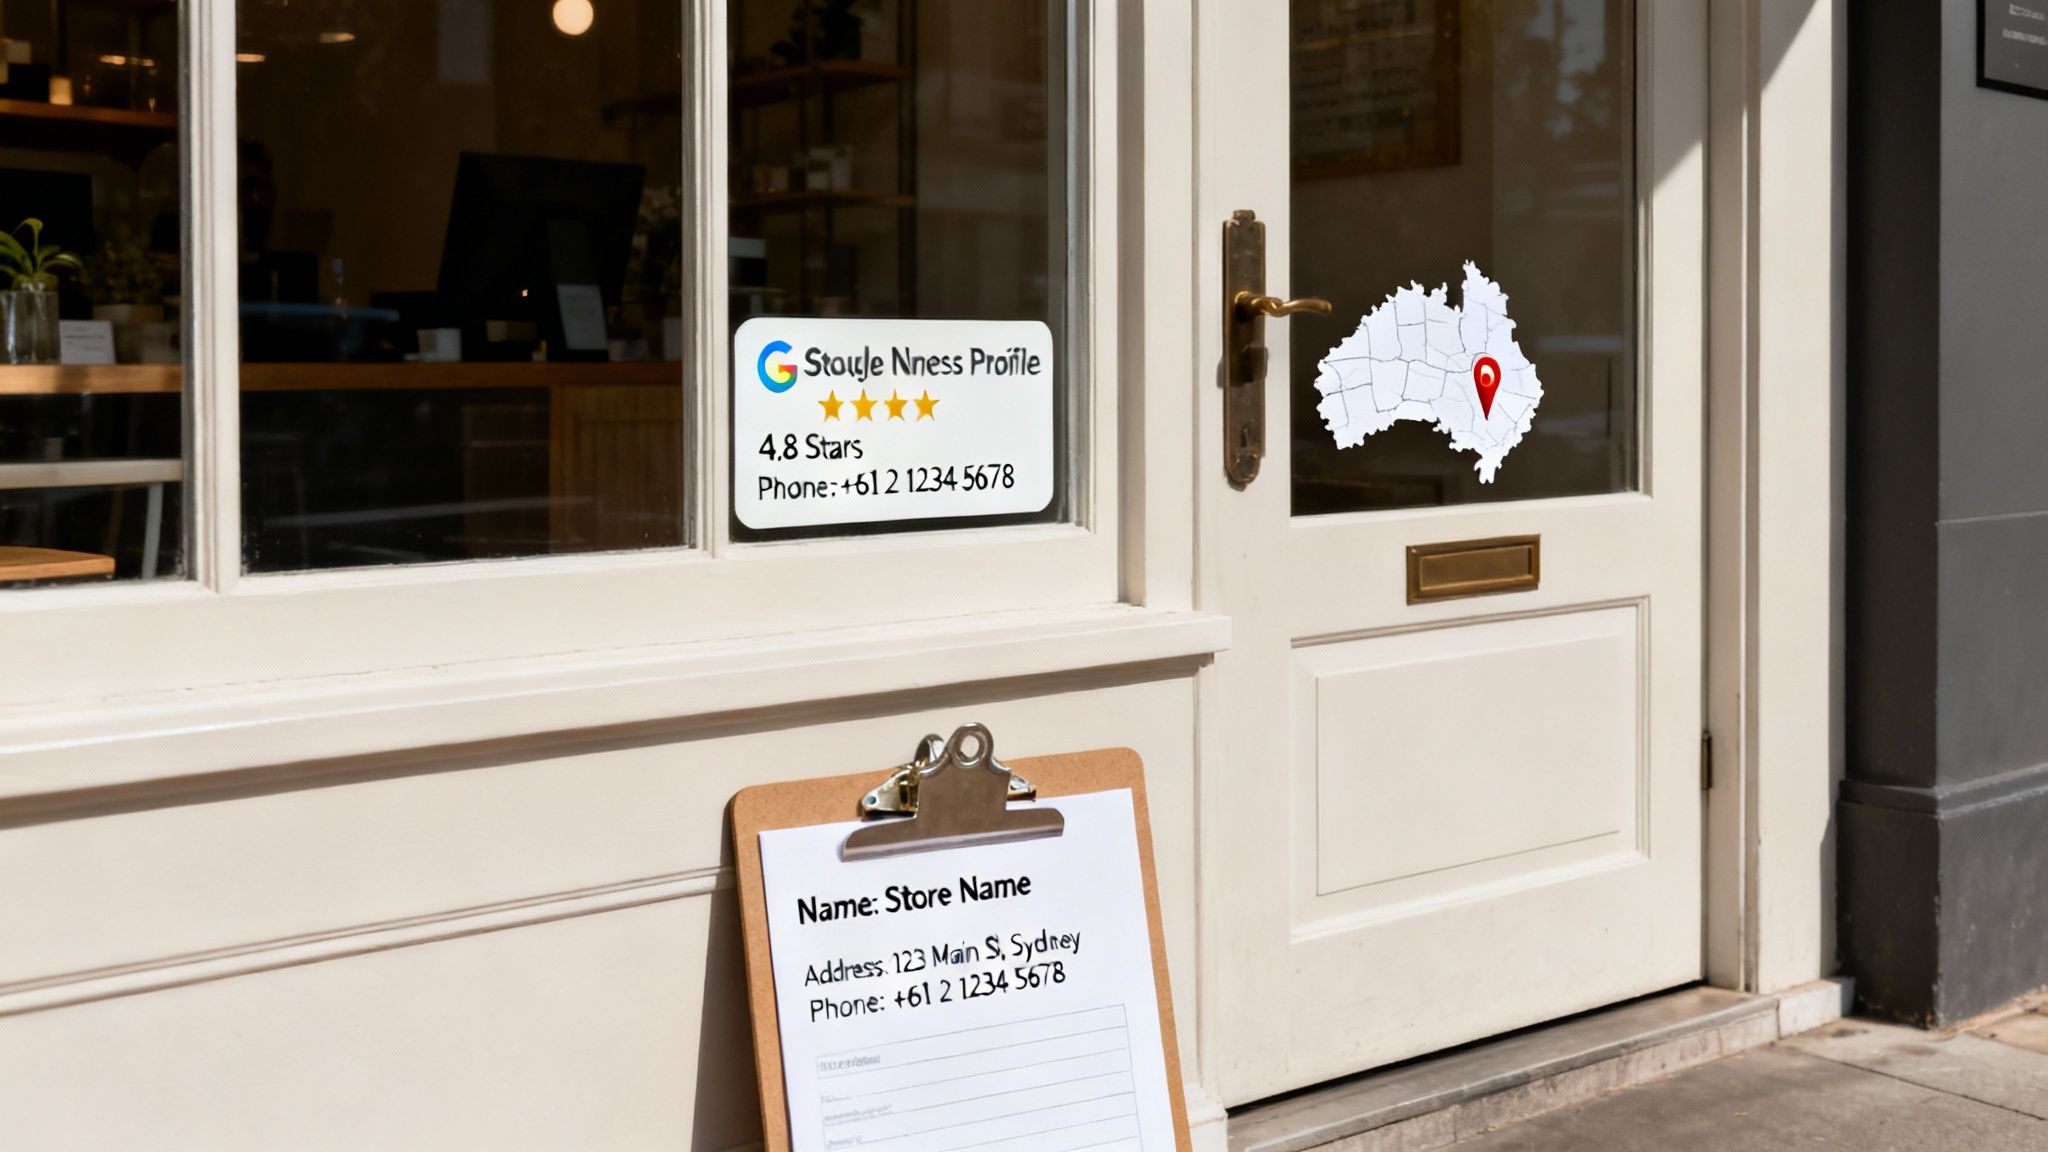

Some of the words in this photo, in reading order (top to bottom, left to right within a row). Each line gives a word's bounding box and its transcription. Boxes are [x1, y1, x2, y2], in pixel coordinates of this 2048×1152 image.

[805, 432, 864, 460] Stars
[840, 469, 879, 496] +61
[884, 468, 900, 495] 2
[906, 465, 959, 493] 1234
[961, 463, 1015, 492] 5678
[797, 895, 879, 925] Name:
[884, 884, 953, 914] Store
[959, 875, 1032, 904] Name
[892, 948, 927, 974] 123
[931, 940, 980, 968] Main
[1010, 928, 1081, 963] Sydney
[810, 995, 886, 1023] Phone:
[894, 981, 932, 1009] +61
[939, 979, 953, 1004] 2
[959, 969, 1010, 1000] 1234
[1014, 960, 1066, 991] 5678
